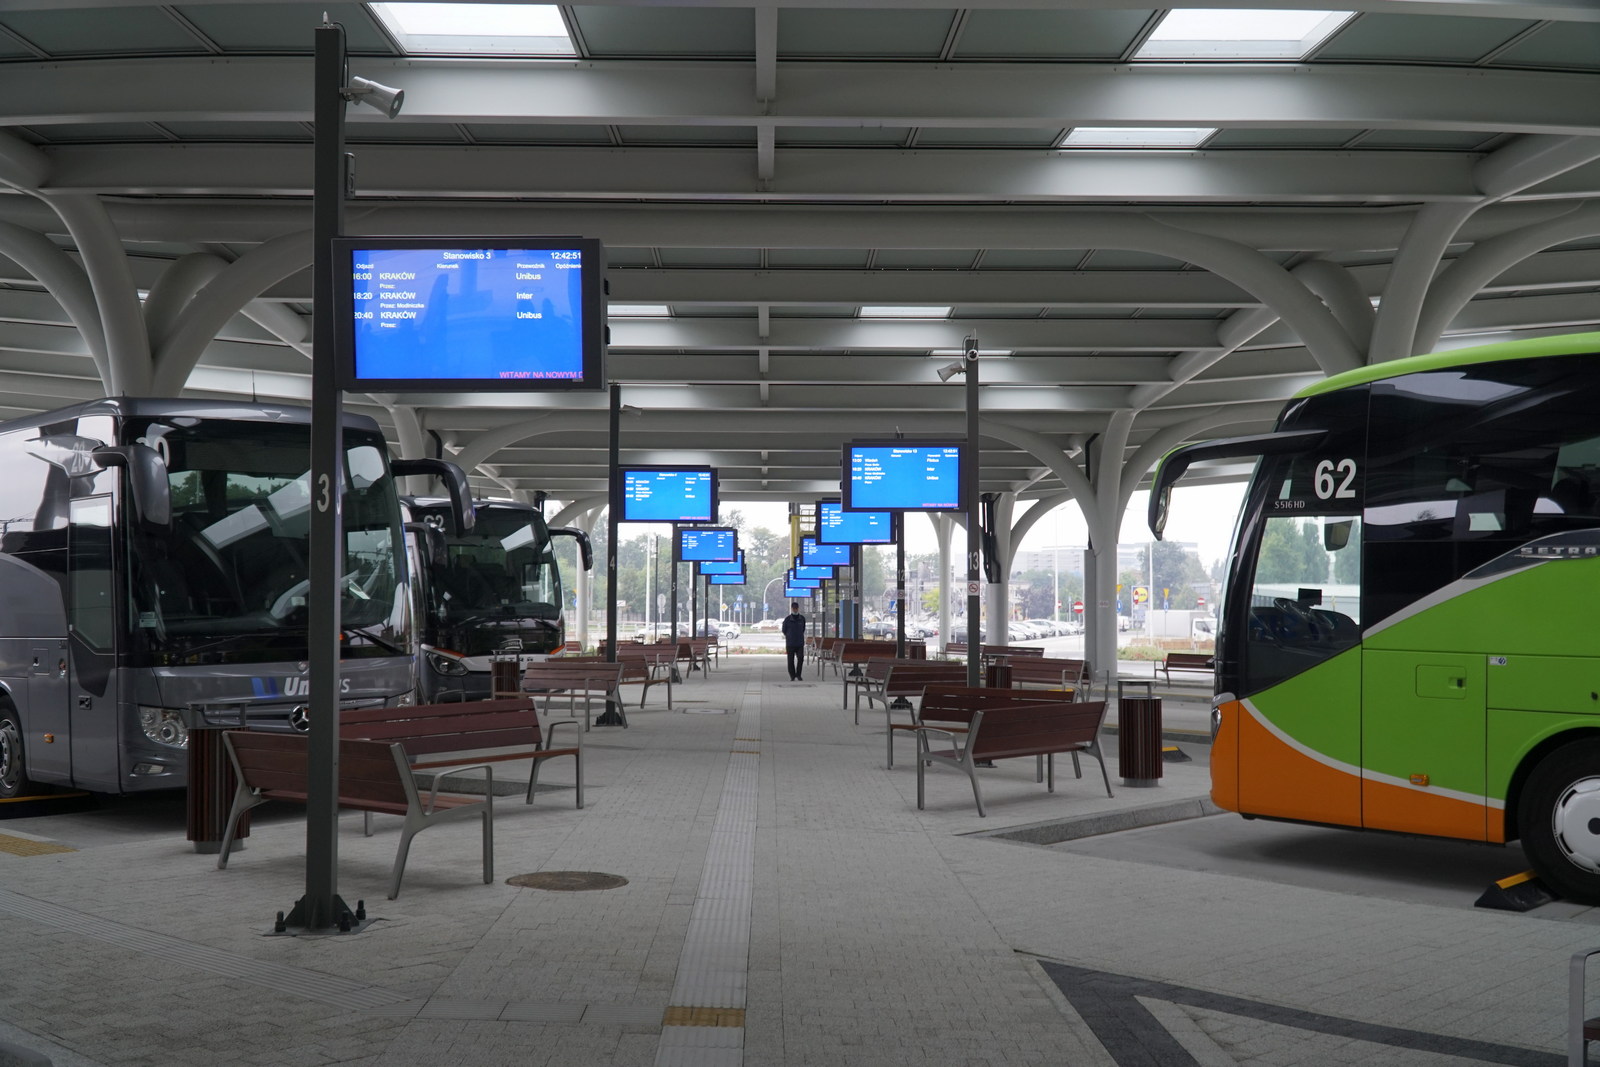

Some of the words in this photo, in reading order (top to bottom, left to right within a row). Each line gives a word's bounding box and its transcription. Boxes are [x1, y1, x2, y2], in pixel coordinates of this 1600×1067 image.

[443, 252, 484, 260] Stanowisko
[486, 252, 491, 260] 3
[551, 252, 581, 260] 12:42:51
[379, 271, 416, 280] KRAKÓW
[516, 272, 541, 280] Unibus
[380, 291, 416, 300] KRAKÓW
[516, 292, 534, 300] Inter
[380, 310, 417, 319] KRAKÓW
[516, 311, 542, 319] Unibus
[499, 371, 531, 379] WITAMY
[533, 371, 544, 379] NA
[545, 371, 577, 379] NOWYM
[1314, 458, 1357, 500] 62
[317, 473, 330, 513] 3
[1275, 501, 1280, 509] S
[1280, 501, 1293, 509] 516
[1294, 500, 1305, 509] HD
[1520, 546, 1597, 555] SETRA
[610, 555, 616, 571] 4
[968, 551, 979, 571] 13
